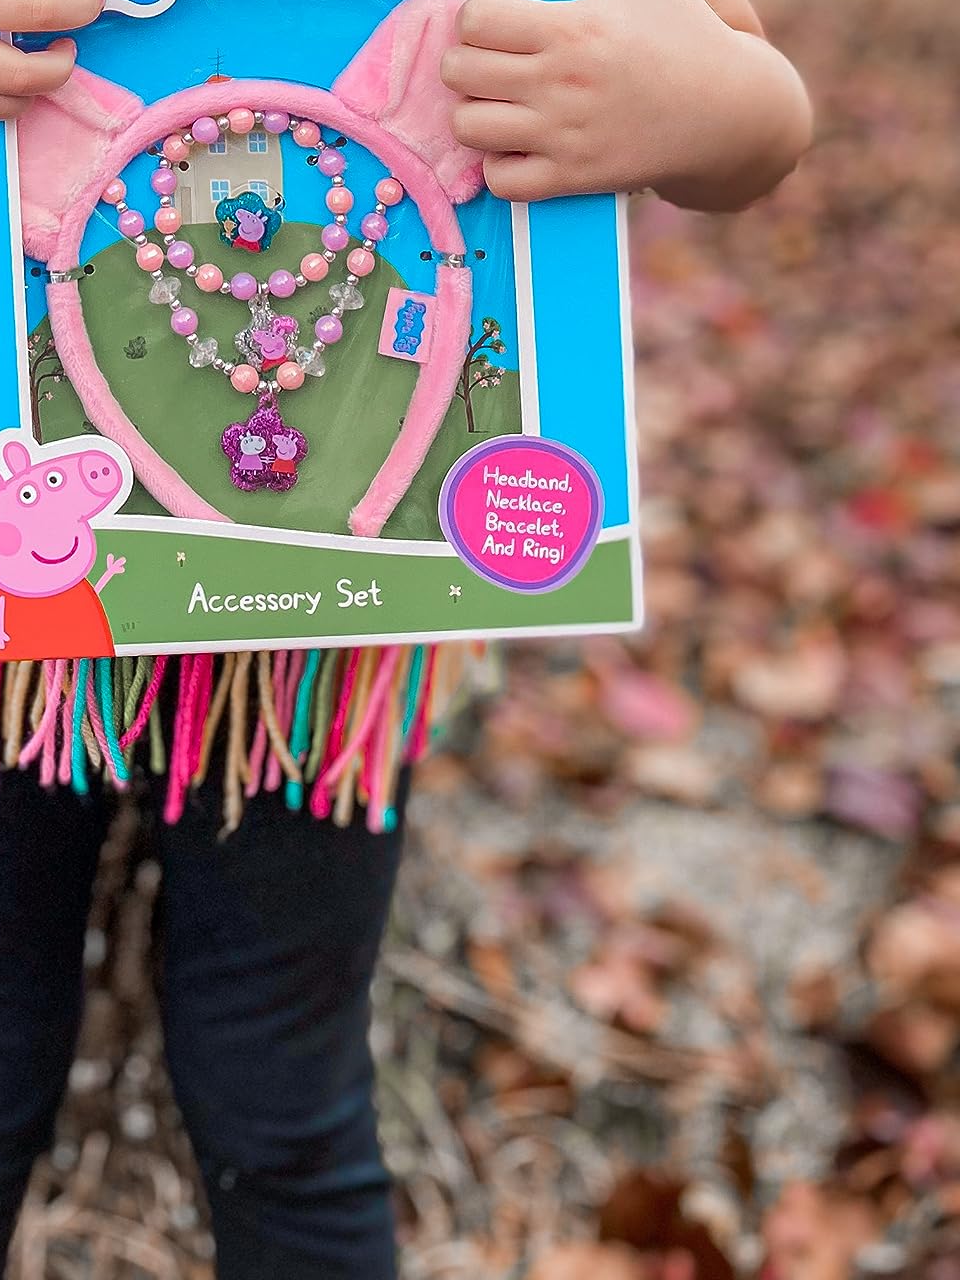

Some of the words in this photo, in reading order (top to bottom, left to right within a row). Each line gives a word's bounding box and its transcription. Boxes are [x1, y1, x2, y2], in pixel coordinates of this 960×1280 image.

[483, 465, 573, 493] Headband,
[486, 489, 567, 515] Necklace,
[485, 511, 564, 538] Bracelet,
[481, 534, 515, 557] And
[522, 538, 565, 565] Ring!
[187, 582, 322, 615] Accessory
[336, 578, 383, 608] Set
